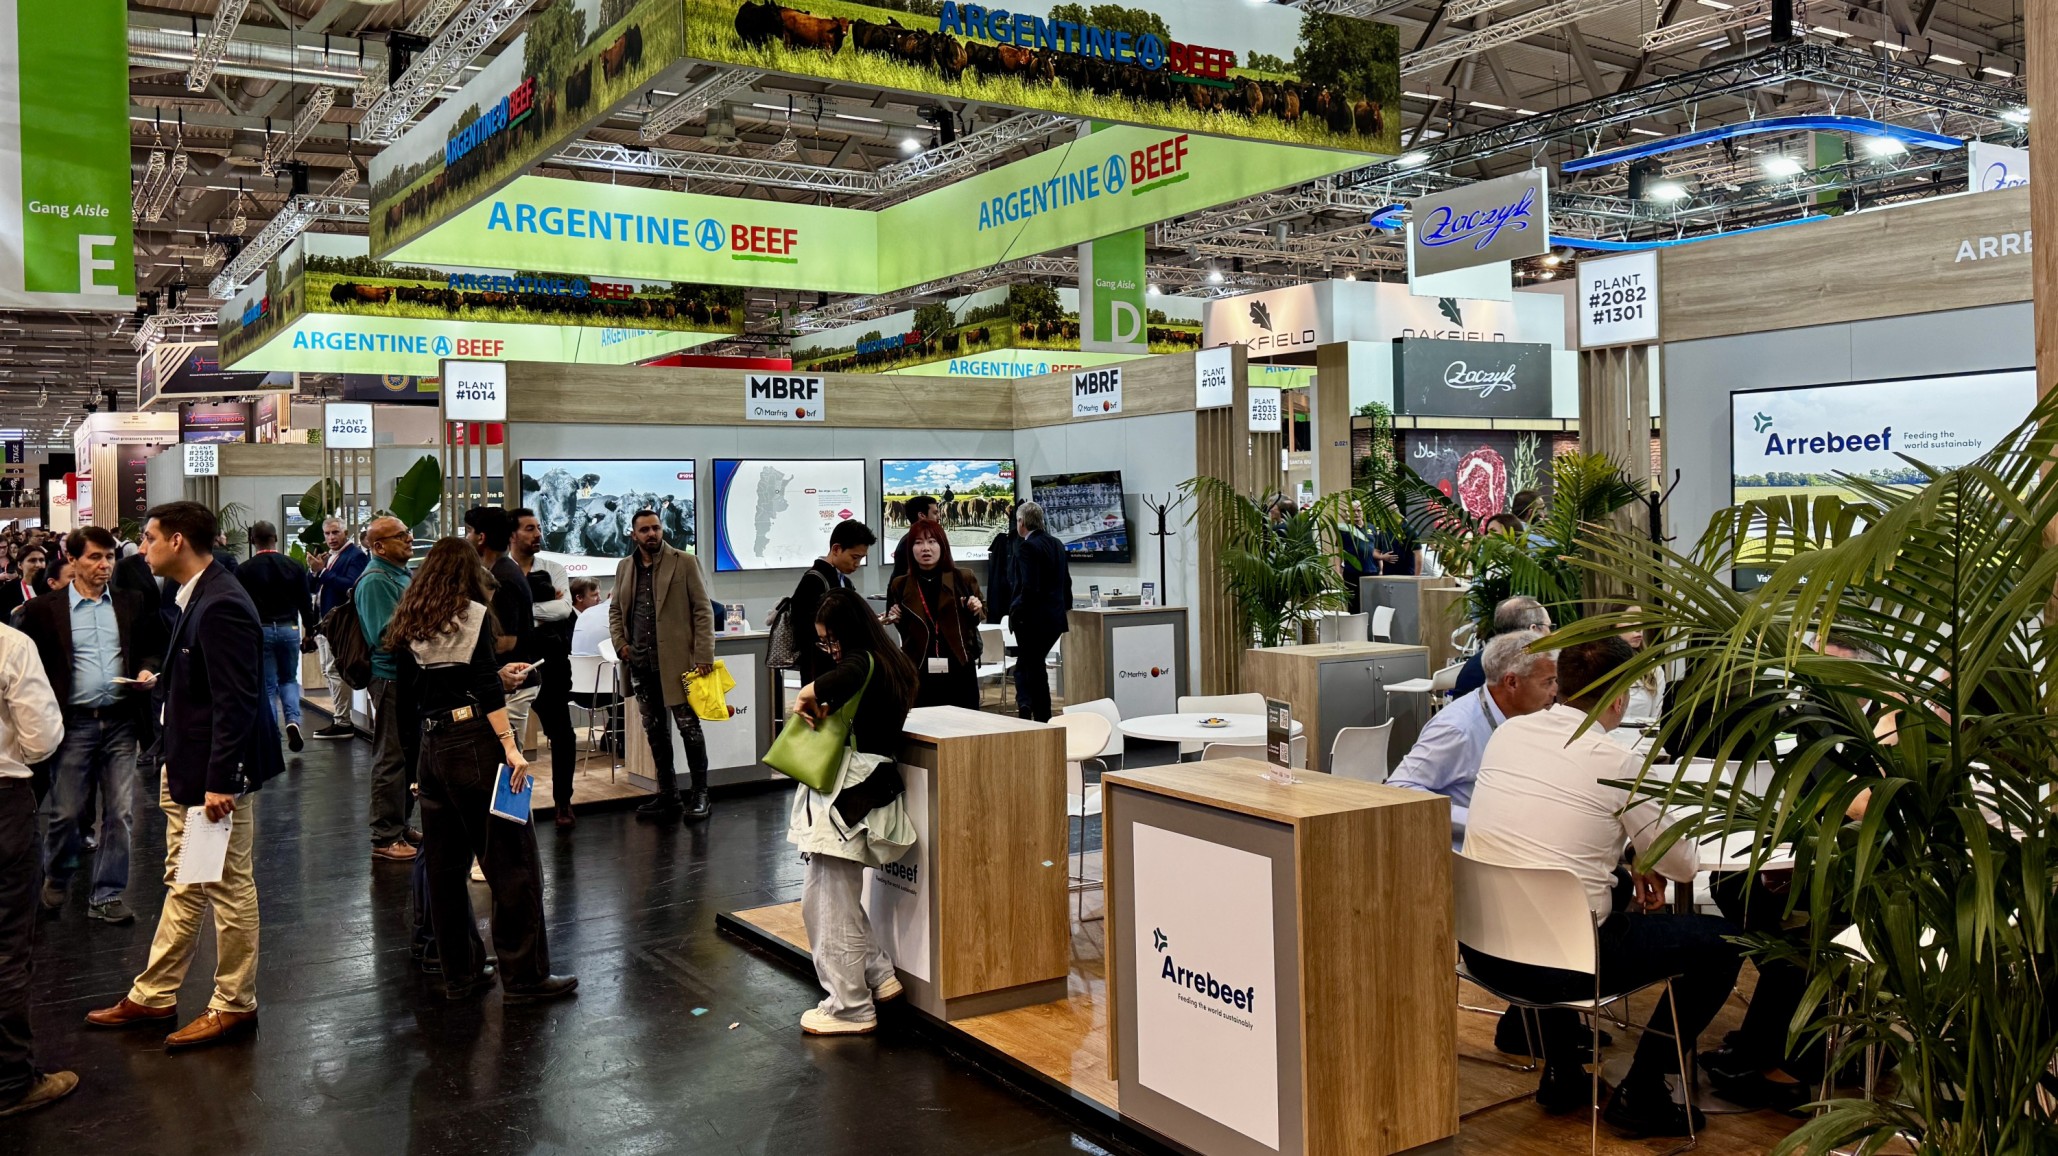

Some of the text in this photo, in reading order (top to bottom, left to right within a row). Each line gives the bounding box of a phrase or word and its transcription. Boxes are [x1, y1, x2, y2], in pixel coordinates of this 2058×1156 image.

[939, 0, 1132, 63] ARGENTINE
[1169, 41, 1235, 78] BEEF
[446, 104, 500, 167] ARGENTINE
[509, 76, 536, 122] BEEF
[979, 165, 1100, 231] ARGENTINE
[1130, 133, 1188, 185] BEEF
[29, 201, 110, 218] Gang Aisle
[487, 201, 690, 247] ARGENTINE
[731, 224, 798, 255] BEEF
[78, 233, 119, 295] E
[447, 273, 566, 297] ARGENTINE
[590, 282, 634, 300] BEEF
[1095, 278, 1136, 290] Gang Aisle
[1594, 273, 1641, 292] PLANT
[1589, 286, 1647, 308] #2082
[1111, 300, 1141, 343] D
[1593, 304, 1643, 325] #1301
[293, 330, 428, 354] ARGENTINE
[456, 338, 505, 357] BEEF
[1219, 329, 1315, 351] KFIELD
[949, 359, 1033, 377] ARGENTINE
[1202, 367, 1225, 377] PLANT
[458, 381, 494, 390] PLANT
[751, 376, 819, 400] MBRF
[1075, 369, 1118, 397] MBRF
[1201, 376, 1226, 388] #1014
[456, 390, 496, 401] #1014
[764, 409, 817, 418] Marfrig brf
[1252, 405, 1277, 413] #2035
[1252, 413, 1277, 421] #3203
[332, 425, 367, 434] #2062
[1903, 430, 1955, 441] Feeding the
[1764, 426, 1892, 456] Arrebeef
[1904, 438, 1982, 449] world sustainably
[1127, 667, 1170, 679] Marfrig brf
[735, 706, 748, 714] brf
[1162, 955, 1254, 1013] Arrebeef
[1177, 993, 1254, 1031] Feeding the world sustainably
